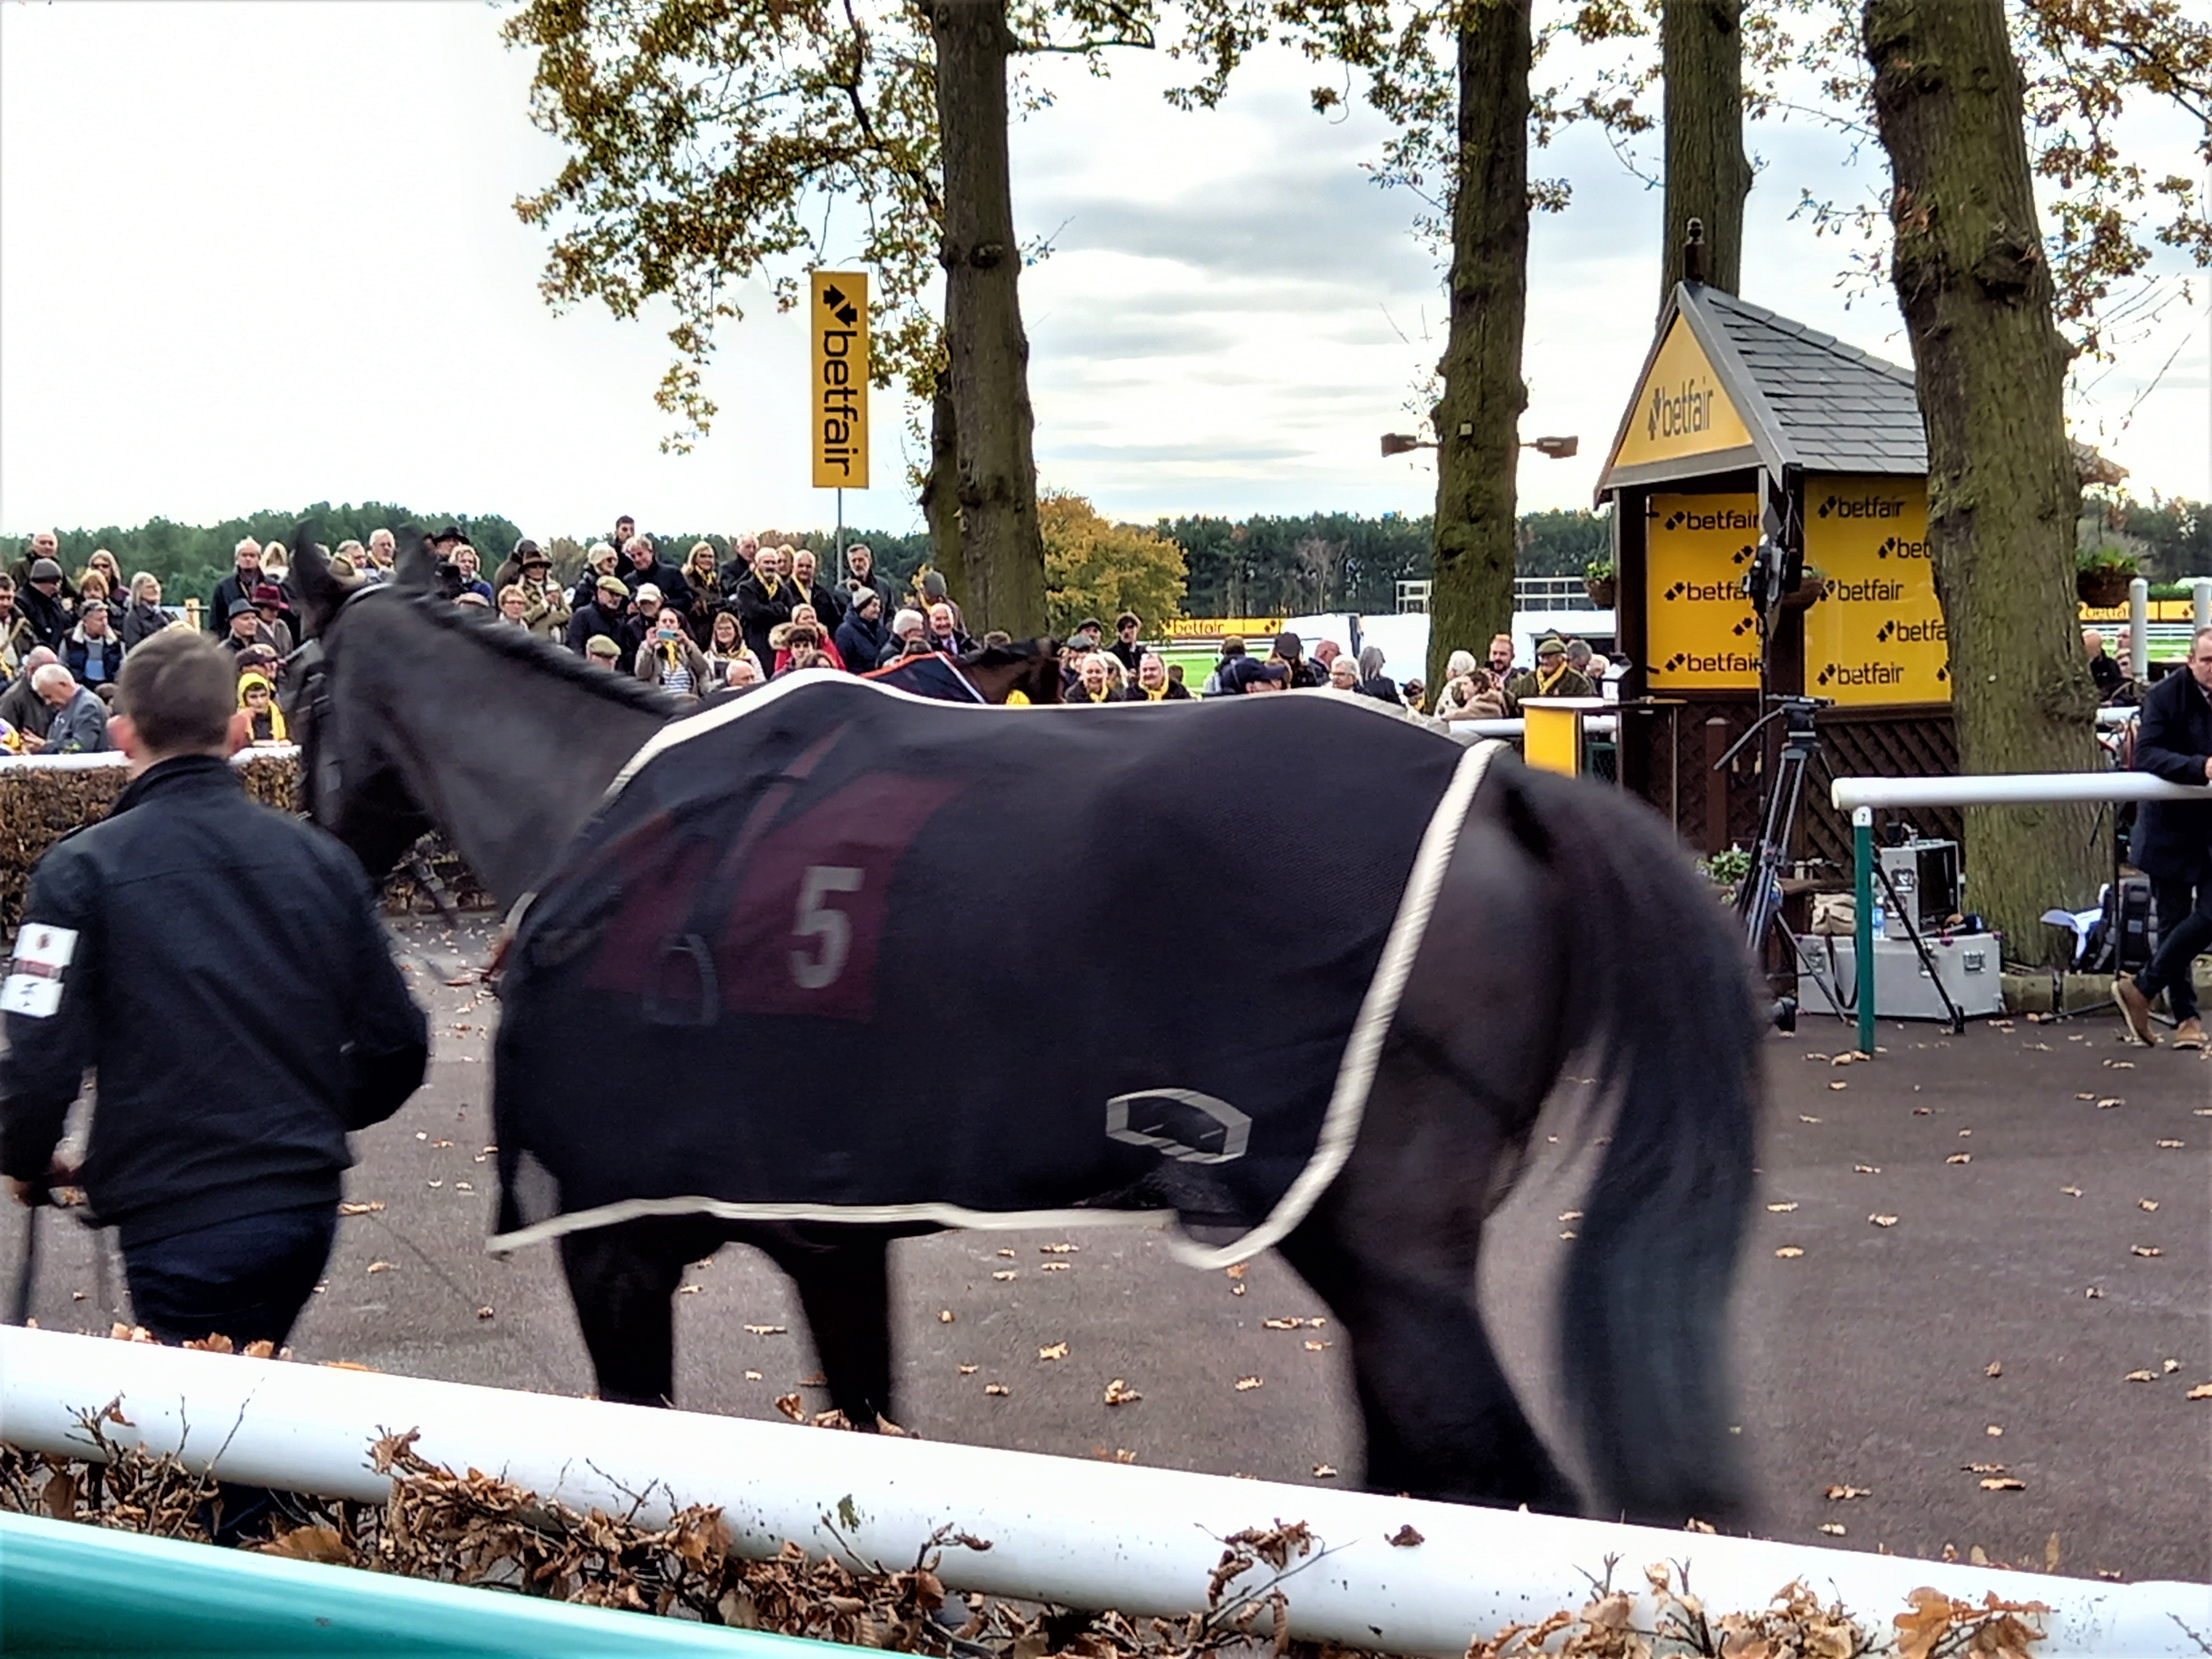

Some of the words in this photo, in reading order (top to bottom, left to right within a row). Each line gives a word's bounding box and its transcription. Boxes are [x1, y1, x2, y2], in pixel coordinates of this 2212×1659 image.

[823, 330, 858, 477] betfair
[1662, 376, 1713, 437] betfair
[1838, 496, 1906, 518] betfair
[1687, 510, 1759, 530] betfair
[1687, 581, 1752, 601] betfa
[1838, 579, 1904, 601] betfair
[1173, 619, 1224, 635] betfair
[1687, 653, 1762, 672] betfair
[1838, 662, 1905, 685] betfair
[790, 865, 867, 989] 5
